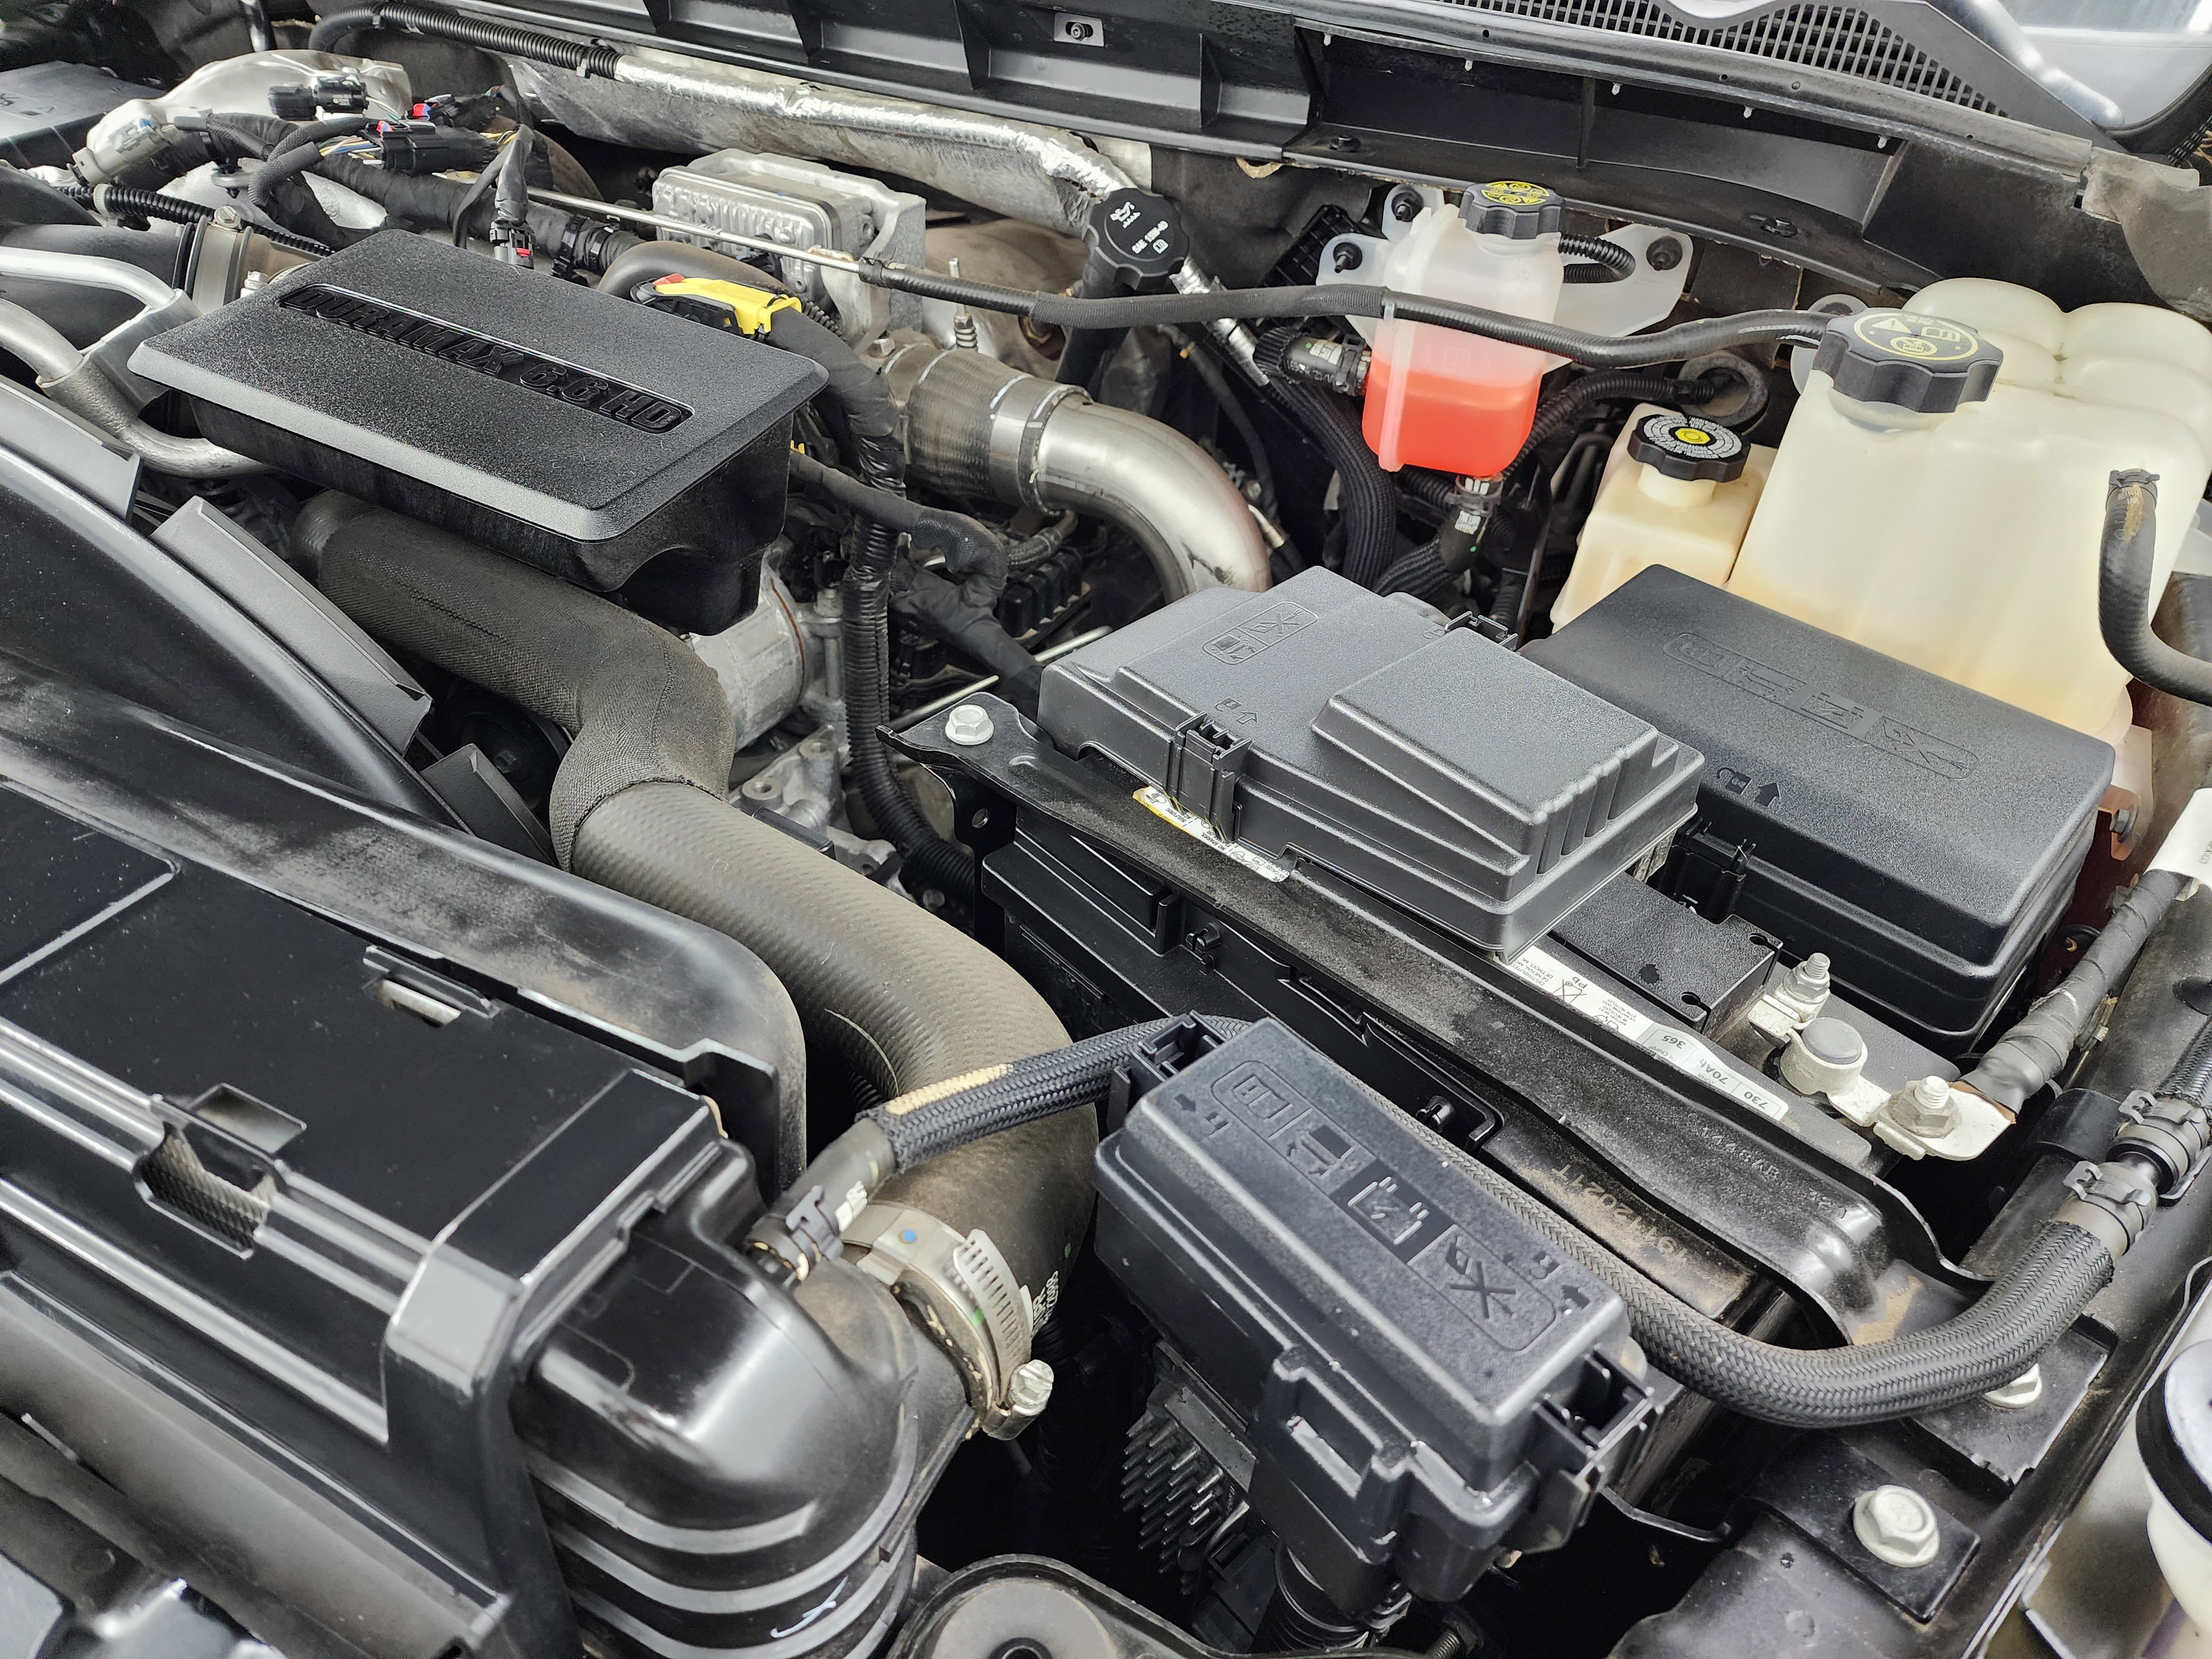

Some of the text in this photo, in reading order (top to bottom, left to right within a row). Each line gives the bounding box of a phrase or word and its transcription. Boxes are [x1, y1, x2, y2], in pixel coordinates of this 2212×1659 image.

[282, 287, 683, 434] DURAMAX 6.6 HD
[1165, 808, 1187, 823] SULFURIC
[1525, 964, 1549, 982] GENERAL
[1571, 975, 1588, 989] Pb
[1661, 1035, 1686, 1049] 365
[1647, 1045, 1668, 1057] Charge
[1698, 1058, 1729, 1085] 70Ah
[1743, 1091, 1768, 1109] 730
